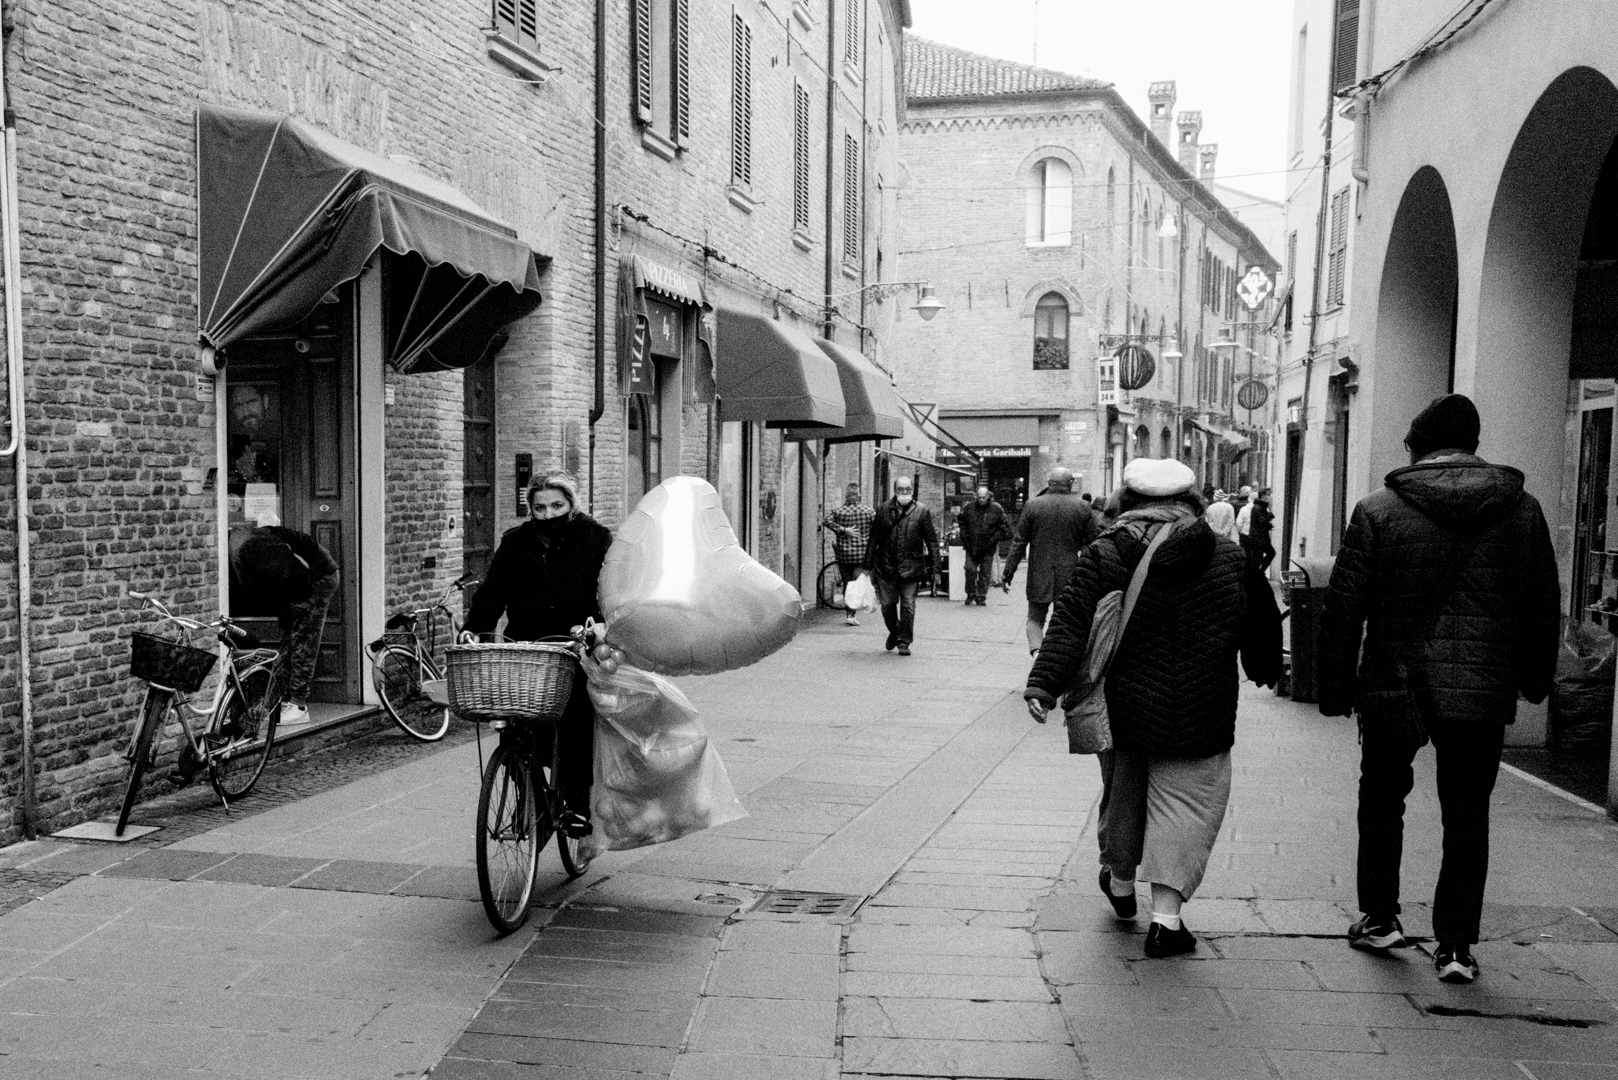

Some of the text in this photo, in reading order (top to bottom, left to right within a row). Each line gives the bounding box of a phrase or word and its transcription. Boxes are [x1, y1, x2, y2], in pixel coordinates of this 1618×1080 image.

[648, 261, 689, 295] PIZZERIA
[1101, 393, 1109, 401] 24
[993, 448, 1032, 457] Garibaldi
